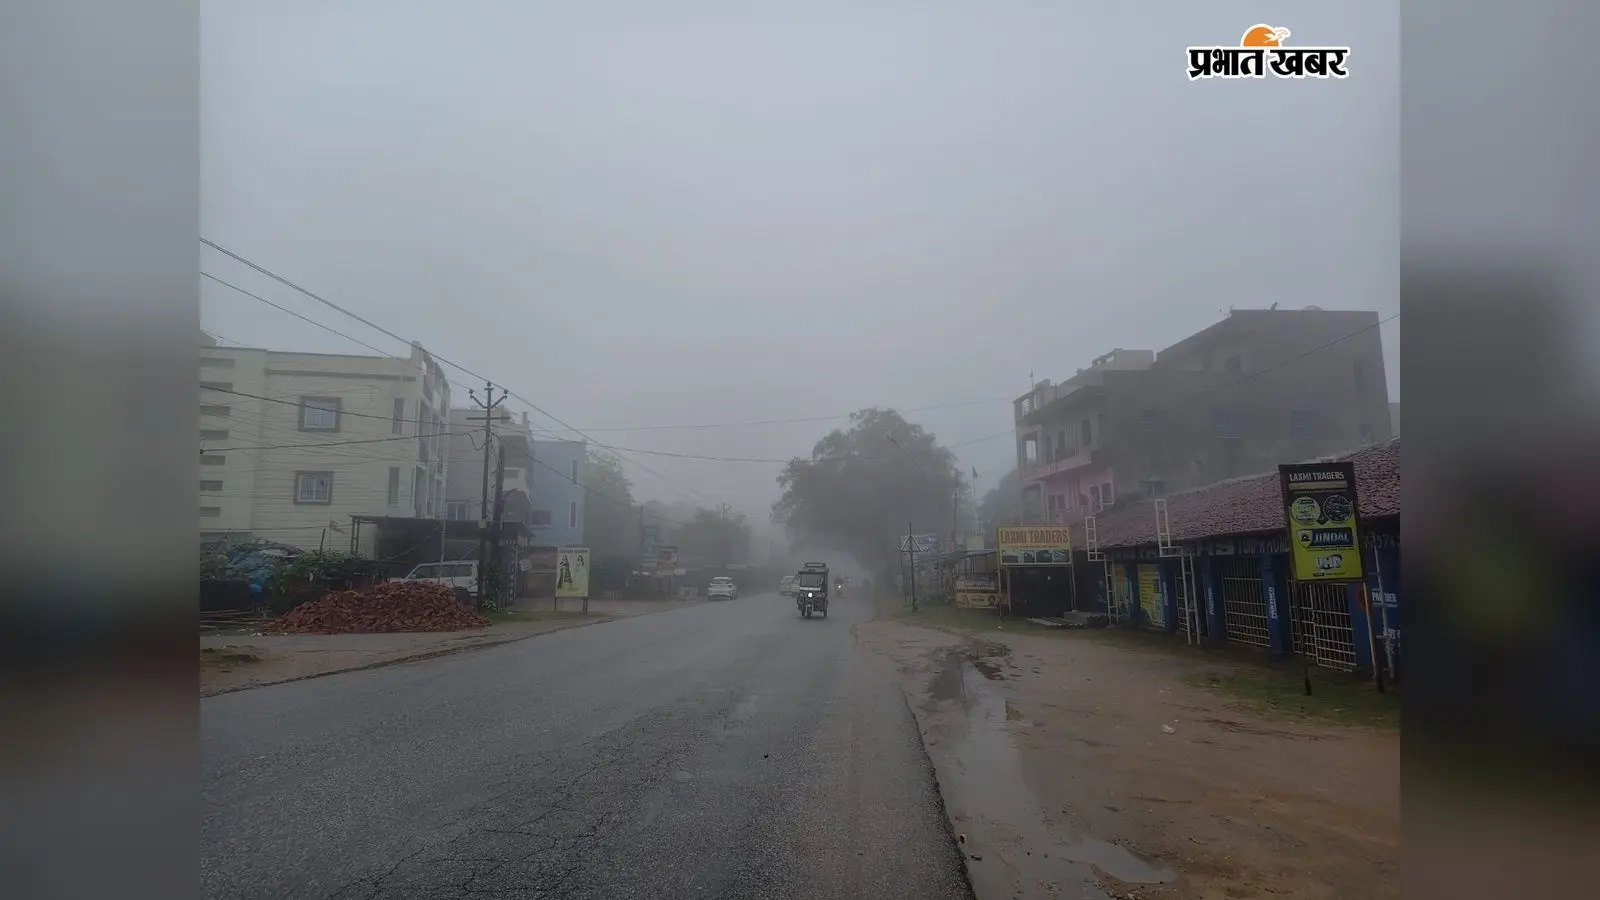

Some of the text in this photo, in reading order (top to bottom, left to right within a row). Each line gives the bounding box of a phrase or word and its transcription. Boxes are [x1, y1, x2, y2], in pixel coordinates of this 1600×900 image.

[1289, 471, 1345, 482] LAXMI TRADERS
[1000, 529, 1069, 544] LAXMI TRADERS
[1315, 531, 1349, 543] JINDAL
